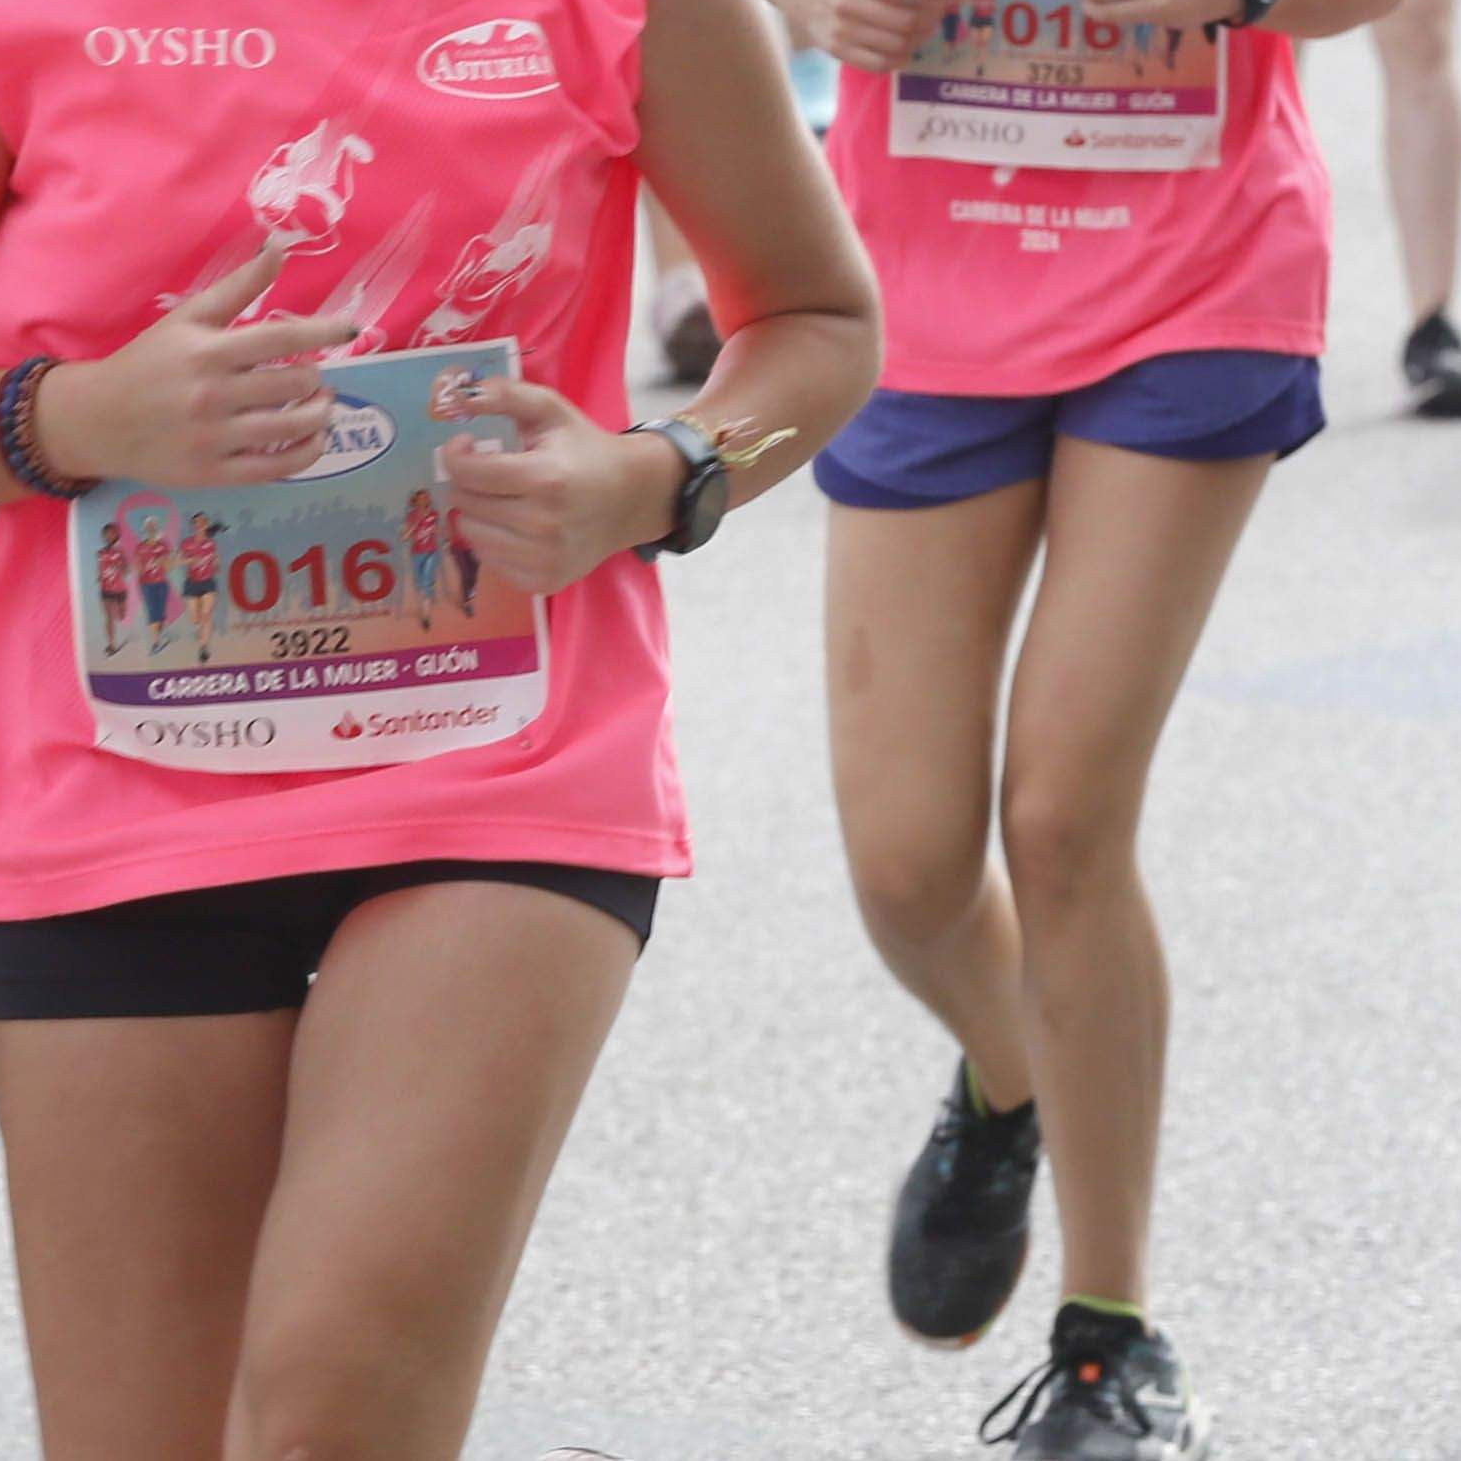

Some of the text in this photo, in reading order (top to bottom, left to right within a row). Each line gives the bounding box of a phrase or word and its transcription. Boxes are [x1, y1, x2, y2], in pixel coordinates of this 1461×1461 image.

[1002, 1, 1121, 51] 016
[84, 26, 277, 69] OYSHO
[1028, 62, 1084, 85] 3763
[1013, 88, 1034, 106] DE
[1038, 90, 1058, 107] LA
[925, 115, 1025, 145] OYSHO
[1089, 130, 1185, 149] Santander
[228, 540, 395, 614] 016
[270, 627, 352, 659] 3922
[147, 673, 247, 701] CARRERA
[253, 668, 285, 694] DE
[289, 666, 319, 691] LA
[323, 656, 398, 687] MUJER
[134, 715, 279, 749] OYSHO
[366, 702, 503, 739] Santander
